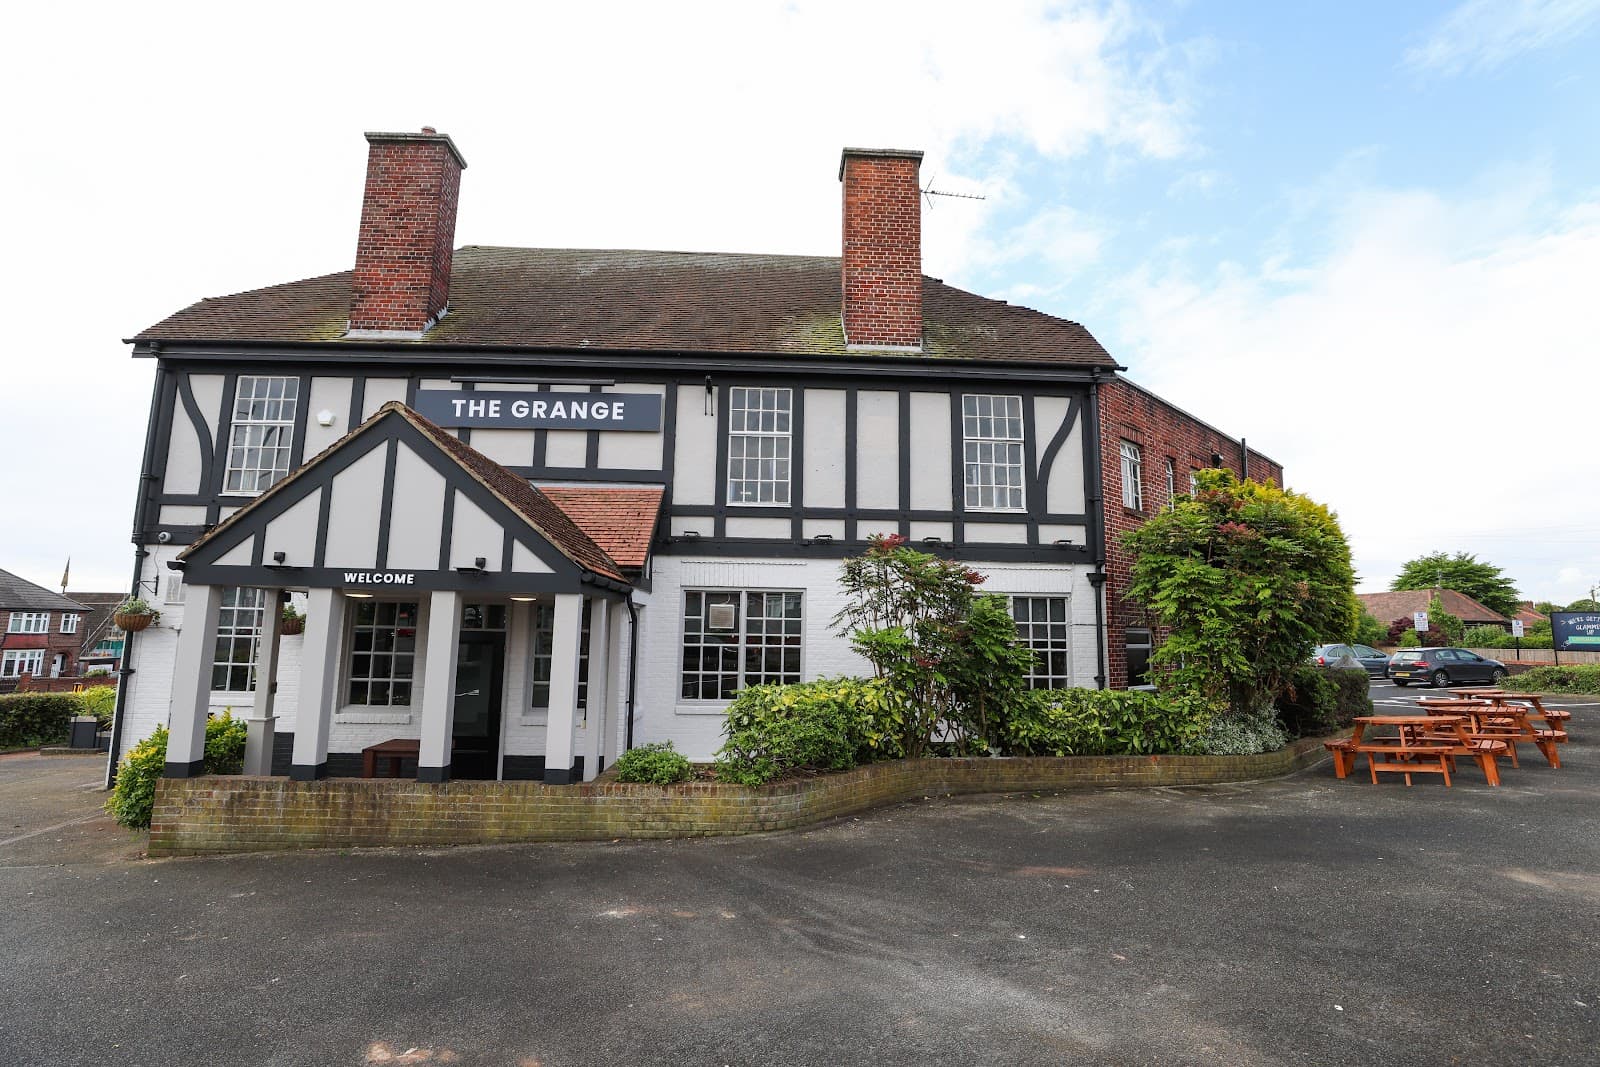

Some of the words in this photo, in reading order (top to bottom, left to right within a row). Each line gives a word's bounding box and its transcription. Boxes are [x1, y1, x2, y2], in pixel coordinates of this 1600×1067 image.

[452, 399, 501, 418] THE
[511, 400, 625, 420] GRANGE
[344, 572, 415, 584] WELCOME
